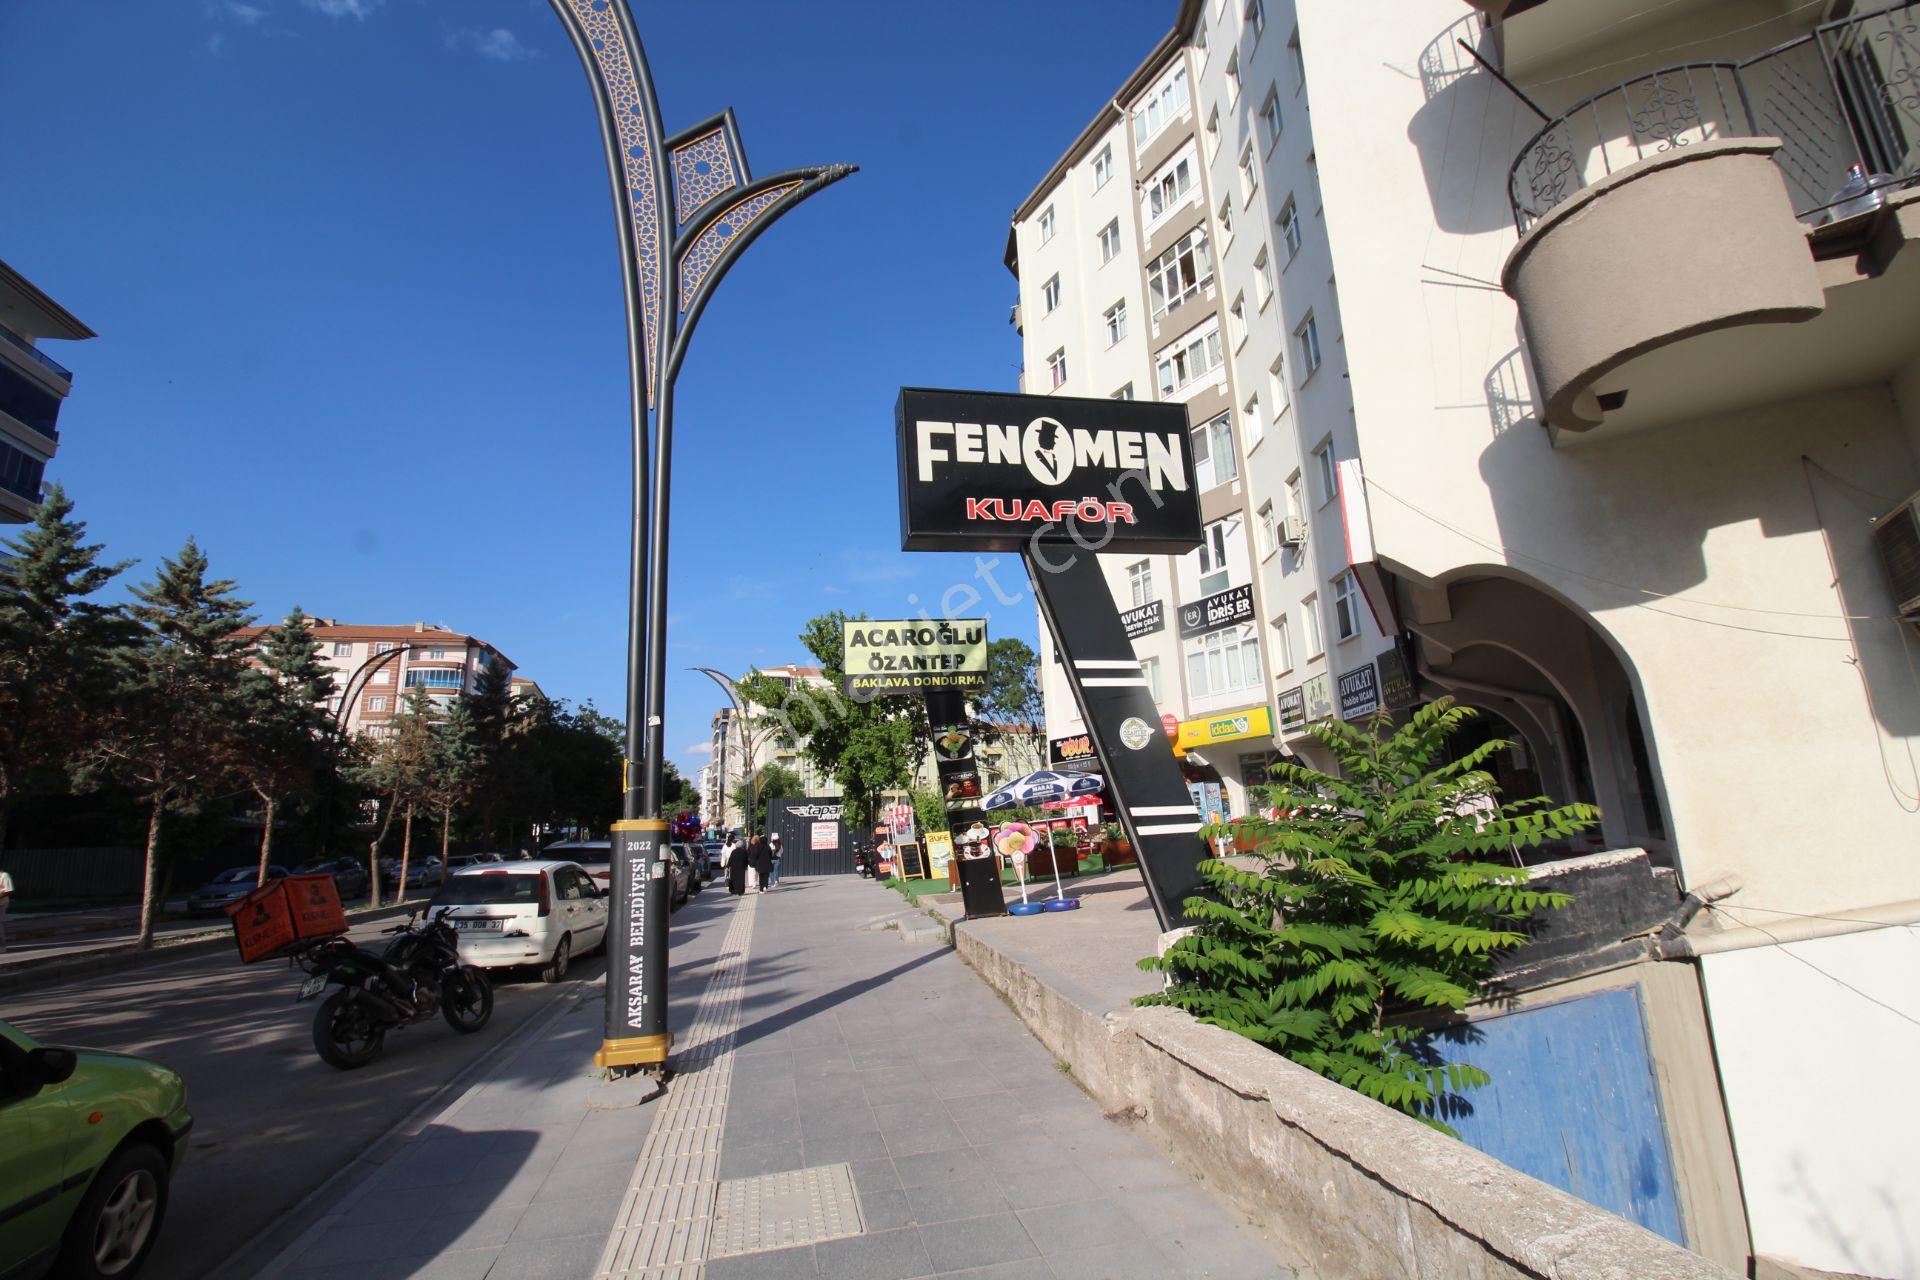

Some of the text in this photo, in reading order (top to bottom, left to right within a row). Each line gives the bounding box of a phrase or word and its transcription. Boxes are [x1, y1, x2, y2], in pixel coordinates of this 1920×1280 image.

[916, 417, 1187, 491] FENOMEN
[966, 496, 1135, 524] KUAFÖR
[1207, 587, 1249, 608] AVUKAT
[1236, 598, 1251, 613] ER
[1121, 603, 1159, 625] AVUKAT
[850, 622, 982, 648] ACAROĞLU
[868, 652, 966, 671] ÖZANTEP
[853, 675, 985, 689] BAKLAVA DONDURMA
[1341, 669, 1372, 696] AVUKAT
[1210, 720, 1237, 737] iddaa
[627, 840, 651, 851] 2022
[627, 857, 646, 1029] AKSARAY BELEDİYESİ
